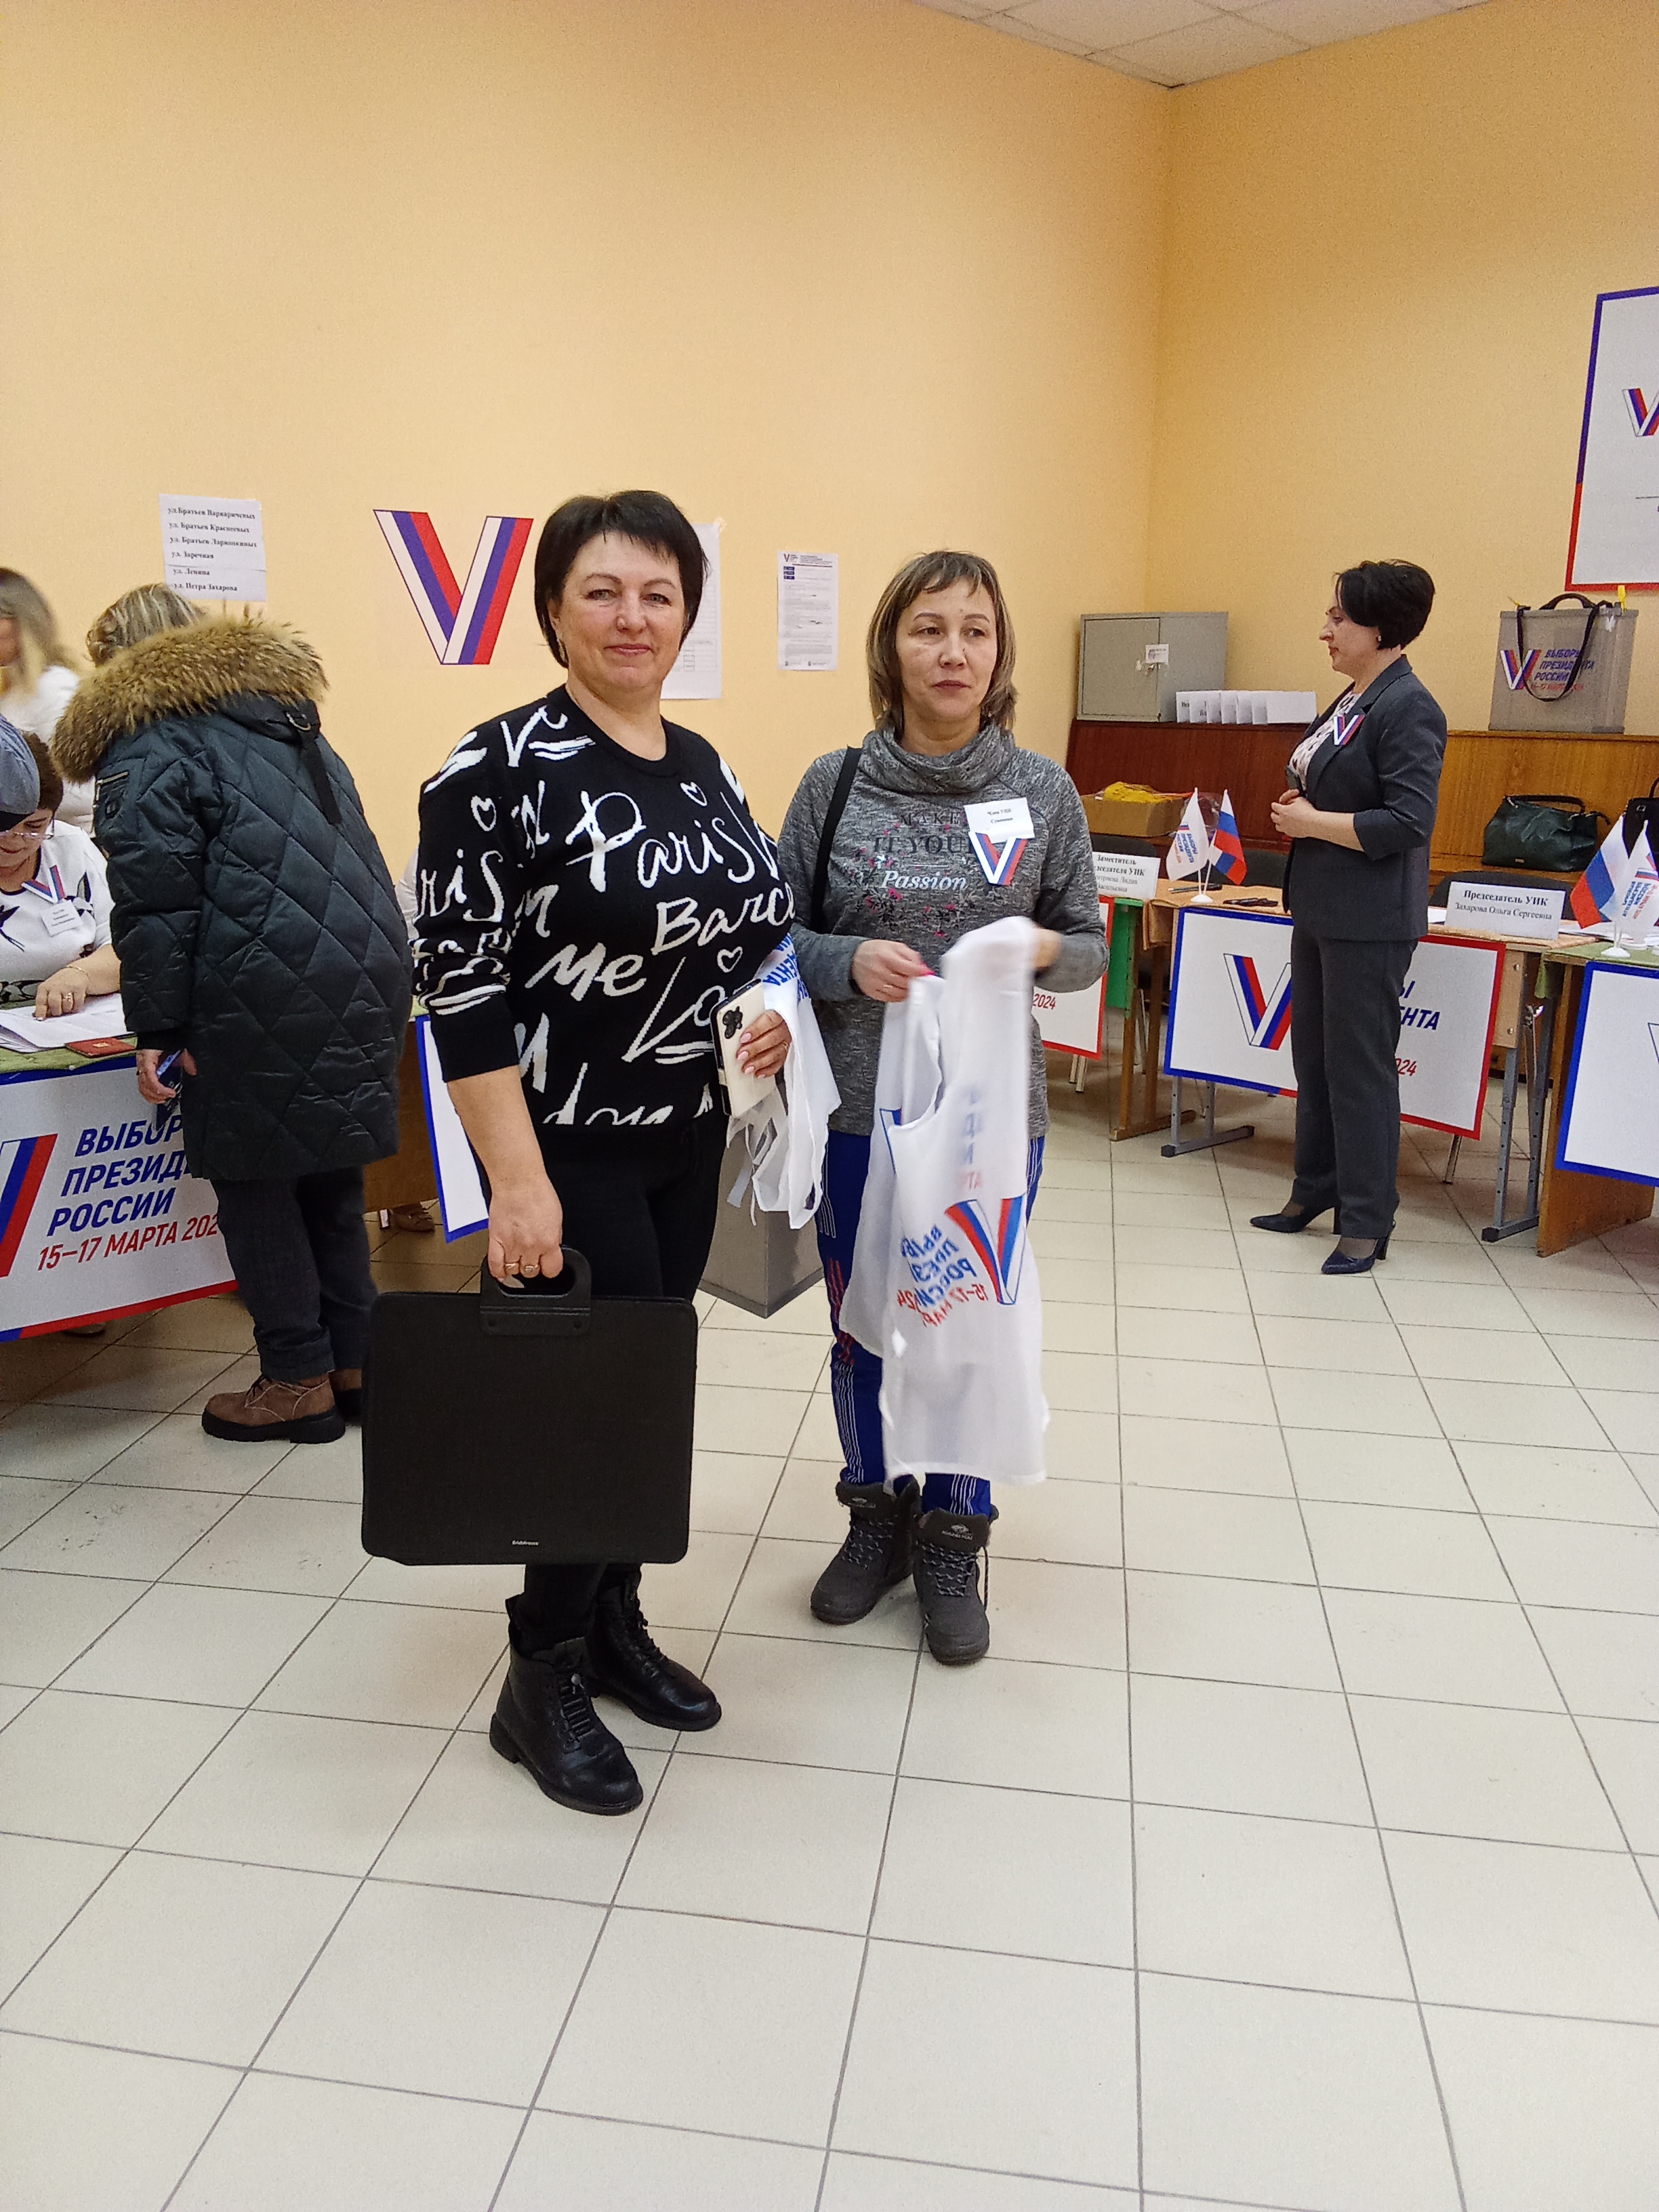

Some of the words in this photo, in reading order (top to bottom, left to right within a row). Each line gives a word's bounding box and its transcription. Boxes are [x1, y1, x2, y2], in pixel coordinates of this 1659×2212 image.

[181, 522, 209, 530] Братьев
[182, 536, 209, 544] Братьев
[184, 551, 214, 560] Заречная
[186, 582, 206, 591] Петра
[1097, 855, 1136, 865] Заместитель
[880, 870, 968, 890] Passion
[1129, 867, 1145, 877] УИК
[1463, 889, 1523, 904] Председатель
[1525, 896, 1549, 907] УИК
[1455, 902, 1488, 913] Захарова
[1489, 906, 1511, 916] Ольга
[1513, 909, 1553, 920] Сергеевна
[75, 1114, 183, 1157] ВЫБОР
[60, 1149, 192, 1197] ПРЕЗИД
[46, 1187, 177, 1237] РОССИИ
[103, 1221, 180, 1258] МАРТА
[180, 1212, 219, 1242] 202
